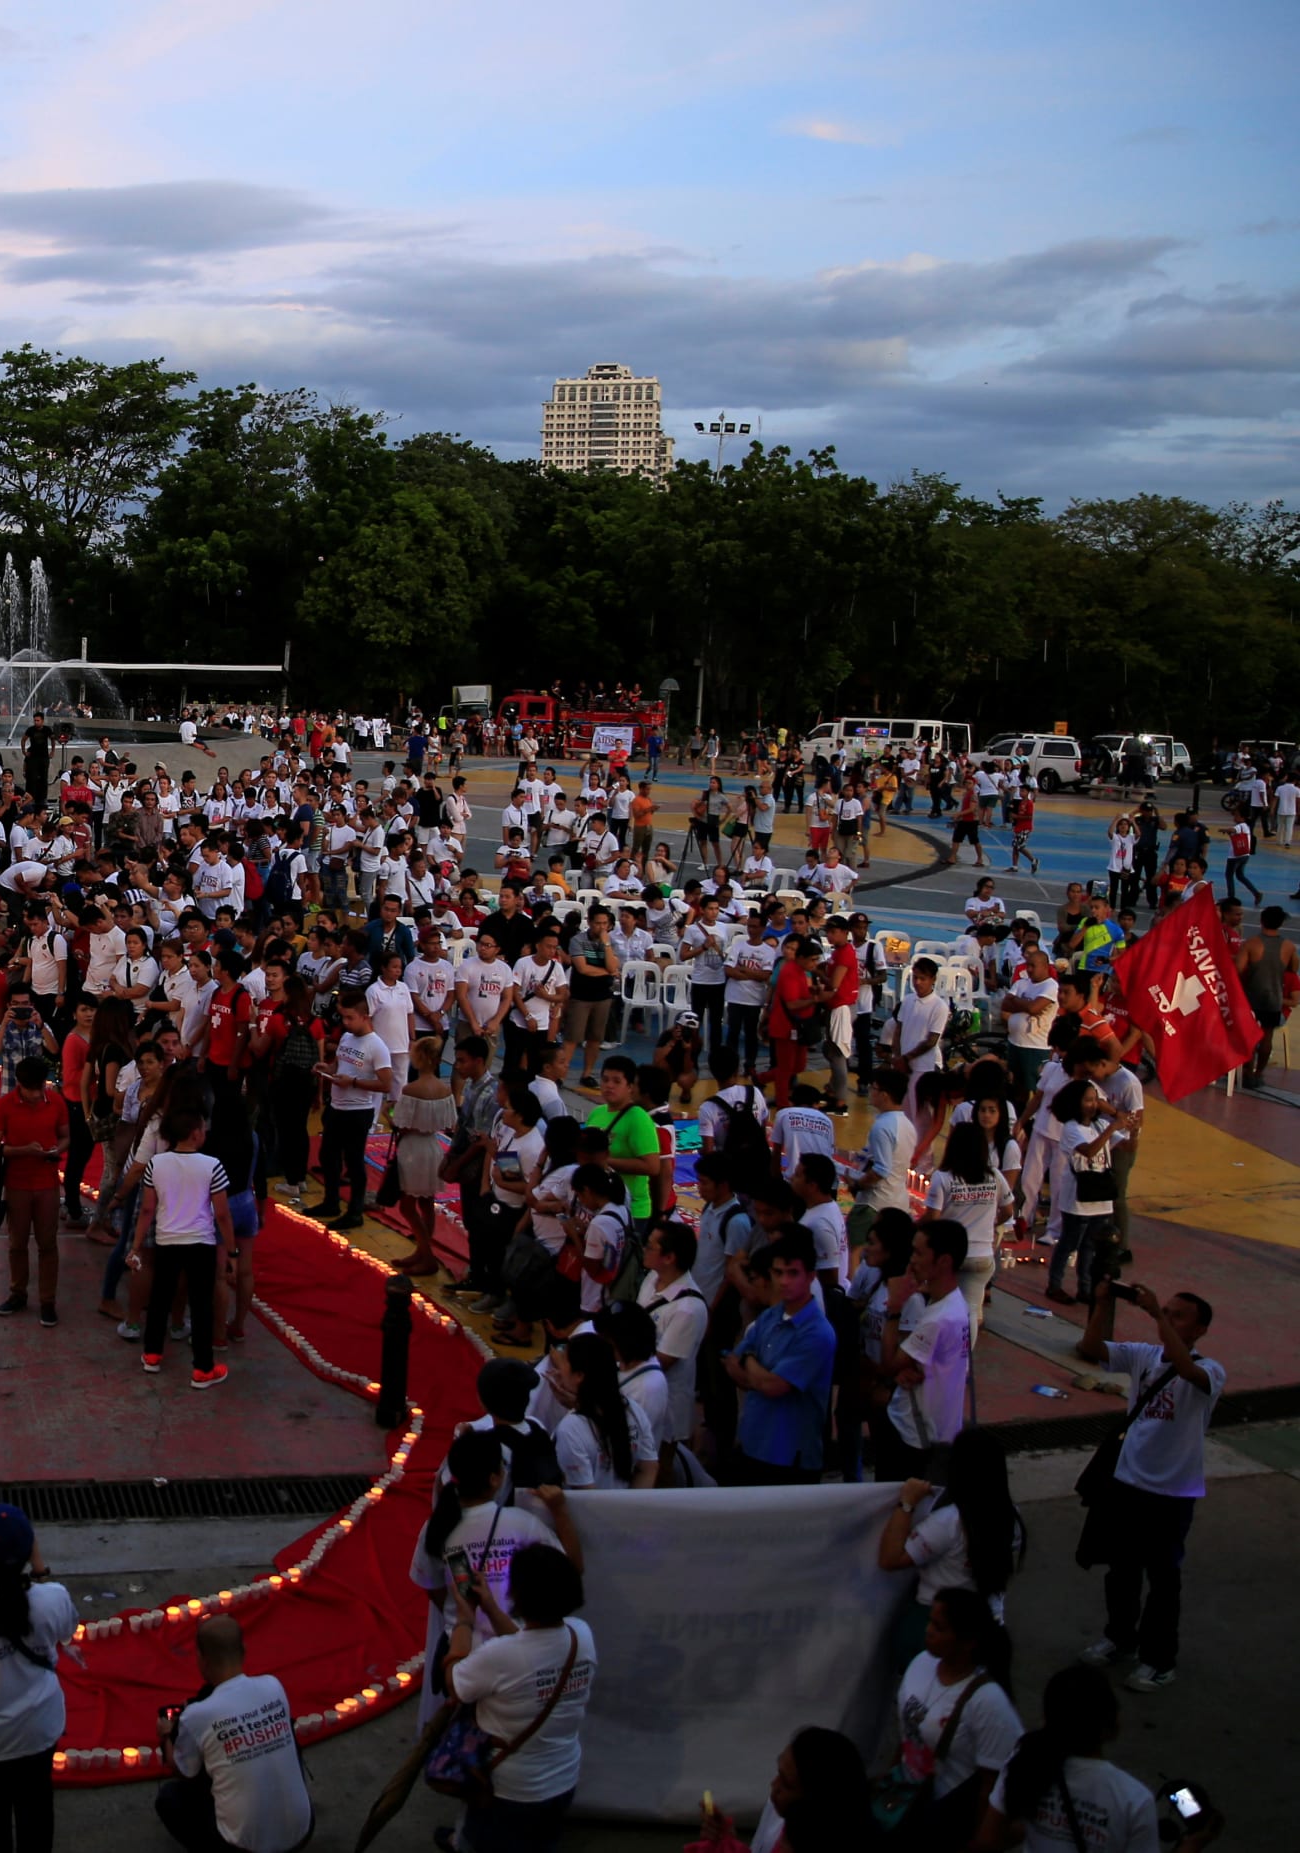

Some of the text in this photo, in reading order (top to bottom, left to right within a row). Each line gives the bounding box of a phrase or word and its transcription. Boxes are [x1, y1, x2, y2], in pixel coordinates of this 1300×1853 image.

[479, 981, 500, 991] AIDS
[968, 1185, 997, 1193] tested
[952, 1191, 996, 1201] #PUSHPh
[446, 1543, 464, 1551] now
[536, 1676, 557, 1688] Get
[538, 1677, 589, 1698] #PSHPh
[212, 1698, 285, 1732] Know your status
[217, 1707, 287, 1741] Get tested
[223, 1720, 290, 1754] #PUSHPh
